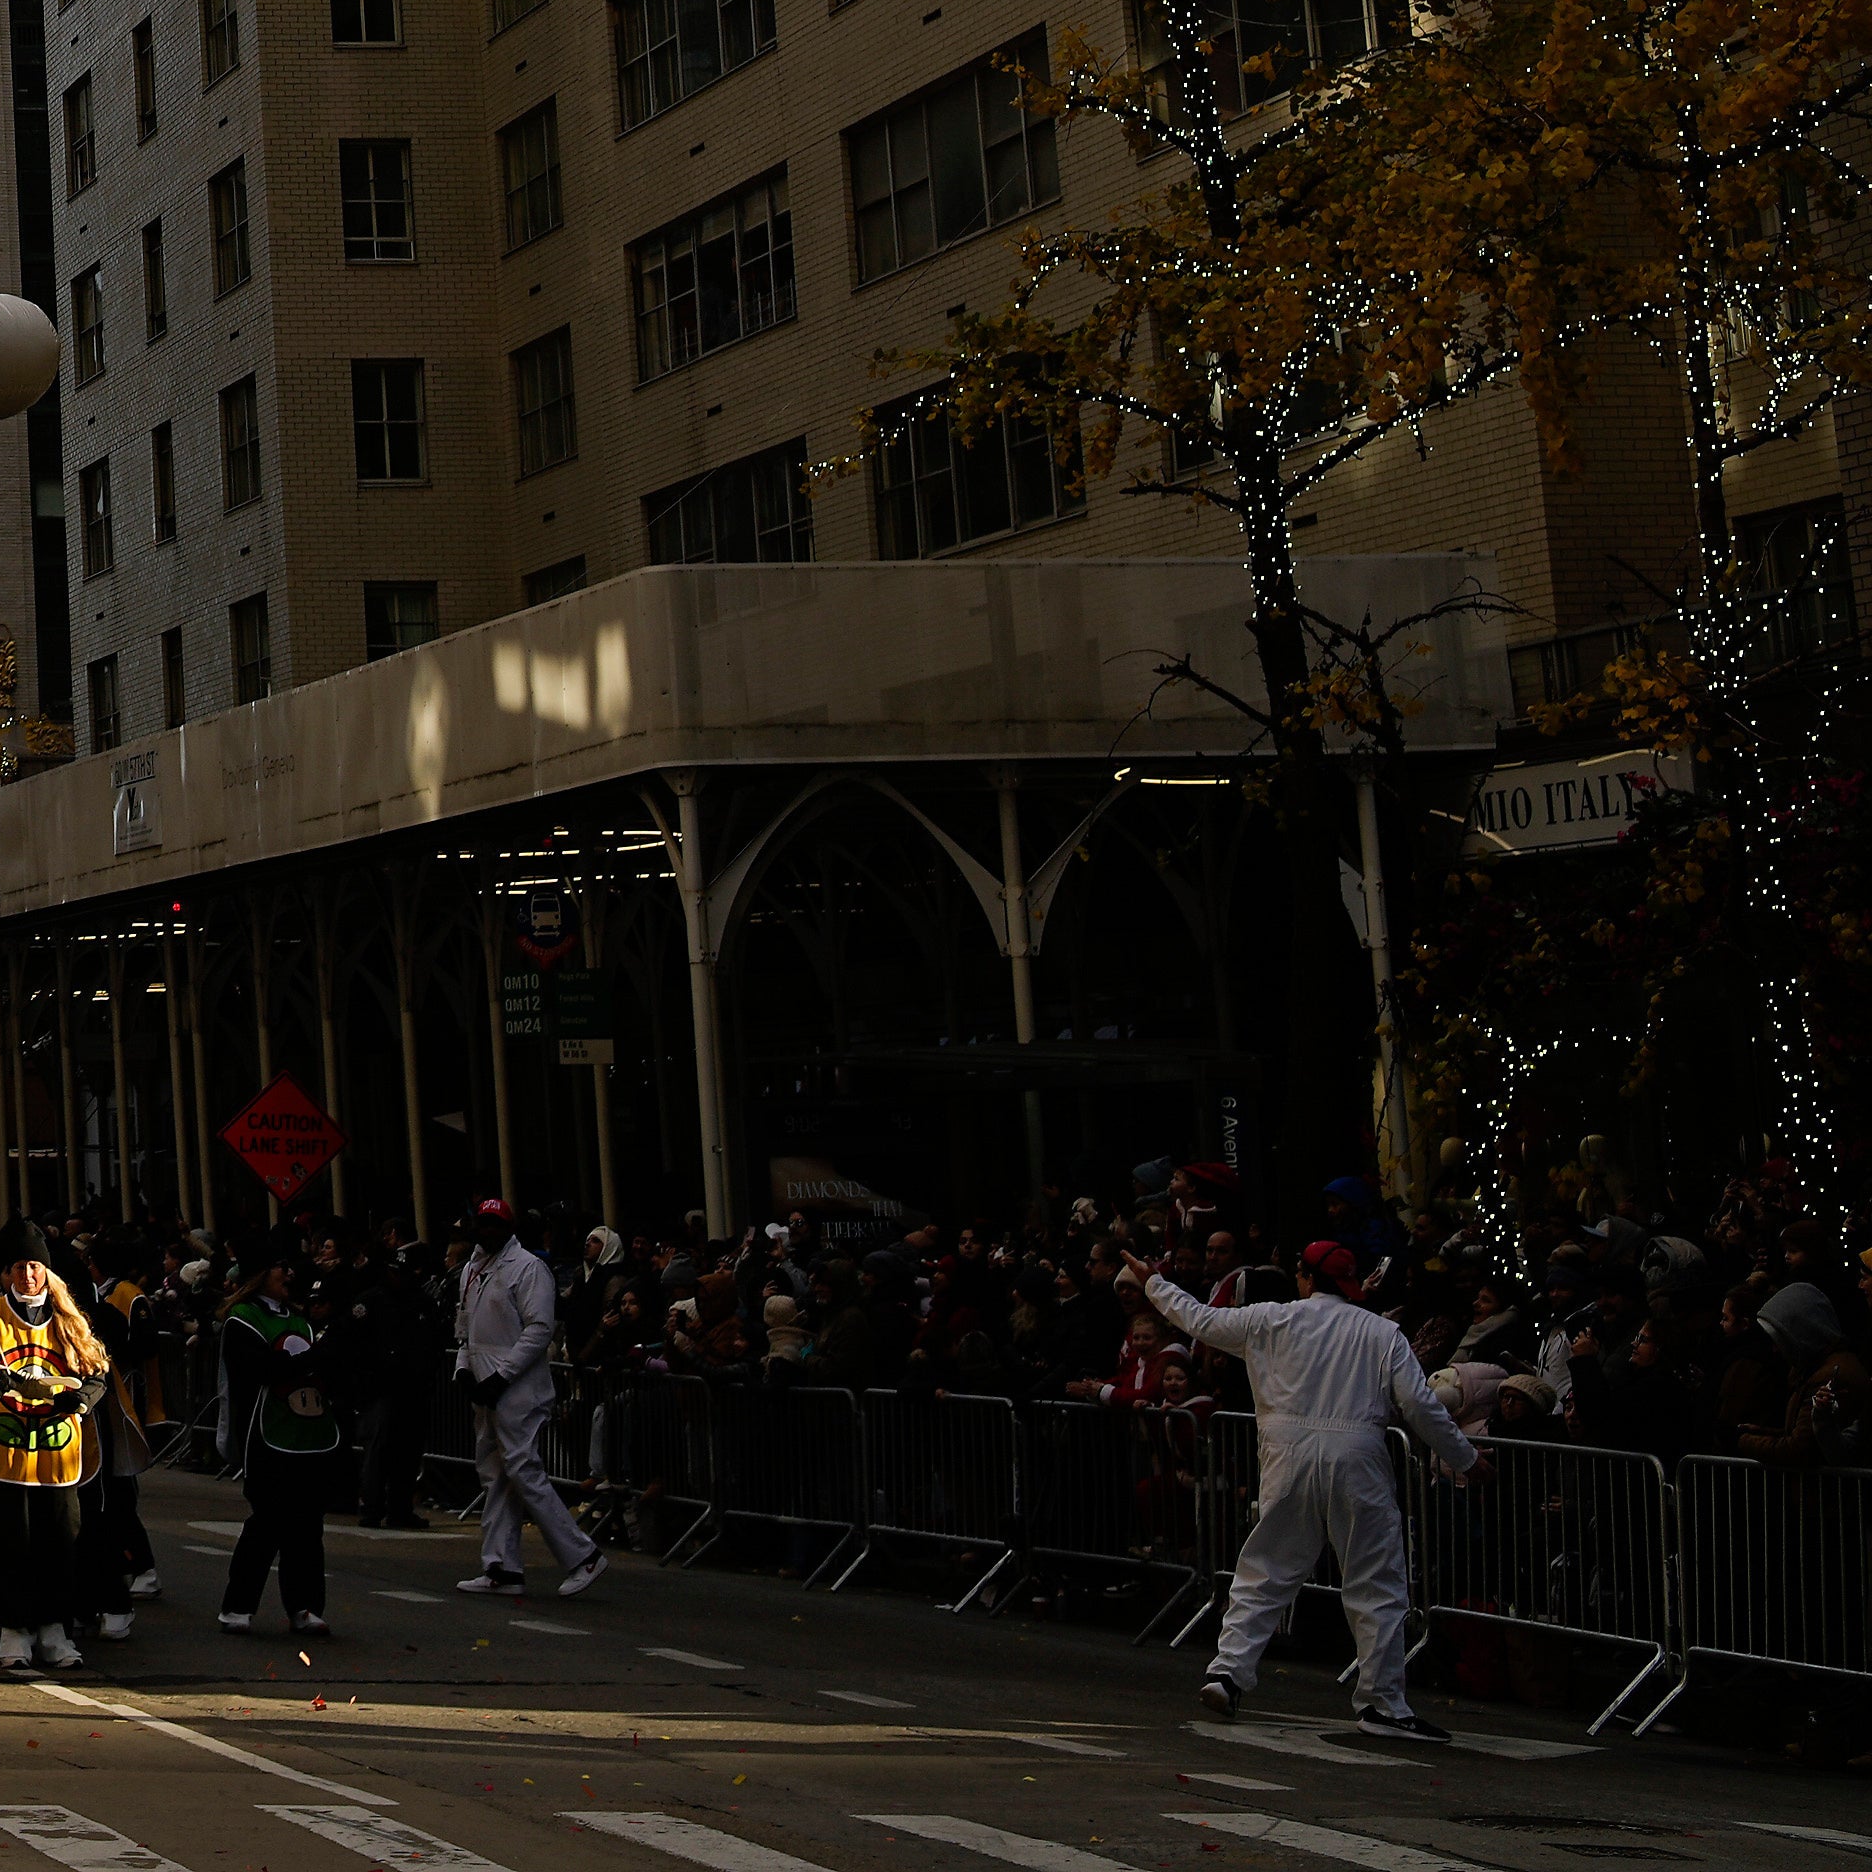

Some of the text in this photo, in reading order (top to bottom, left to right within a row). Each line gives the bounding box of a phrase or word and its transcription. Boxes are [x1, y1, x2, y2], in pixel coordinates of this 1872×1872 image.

[1472, 771, 1638, 833] MIO ITALY
[504, 973, 540, 990] QM10
[505, 995, 542, 1012] QM12
[506, 1017, 543, 1034] QM24
[1221, 1095, 1237, 1109] 6
[247, 1112, 323, 1132] CAUTION
[239, 1135, 329, 1156] LANE SHIFT
[786, 1179, 872, 1201] DIAMONDS
